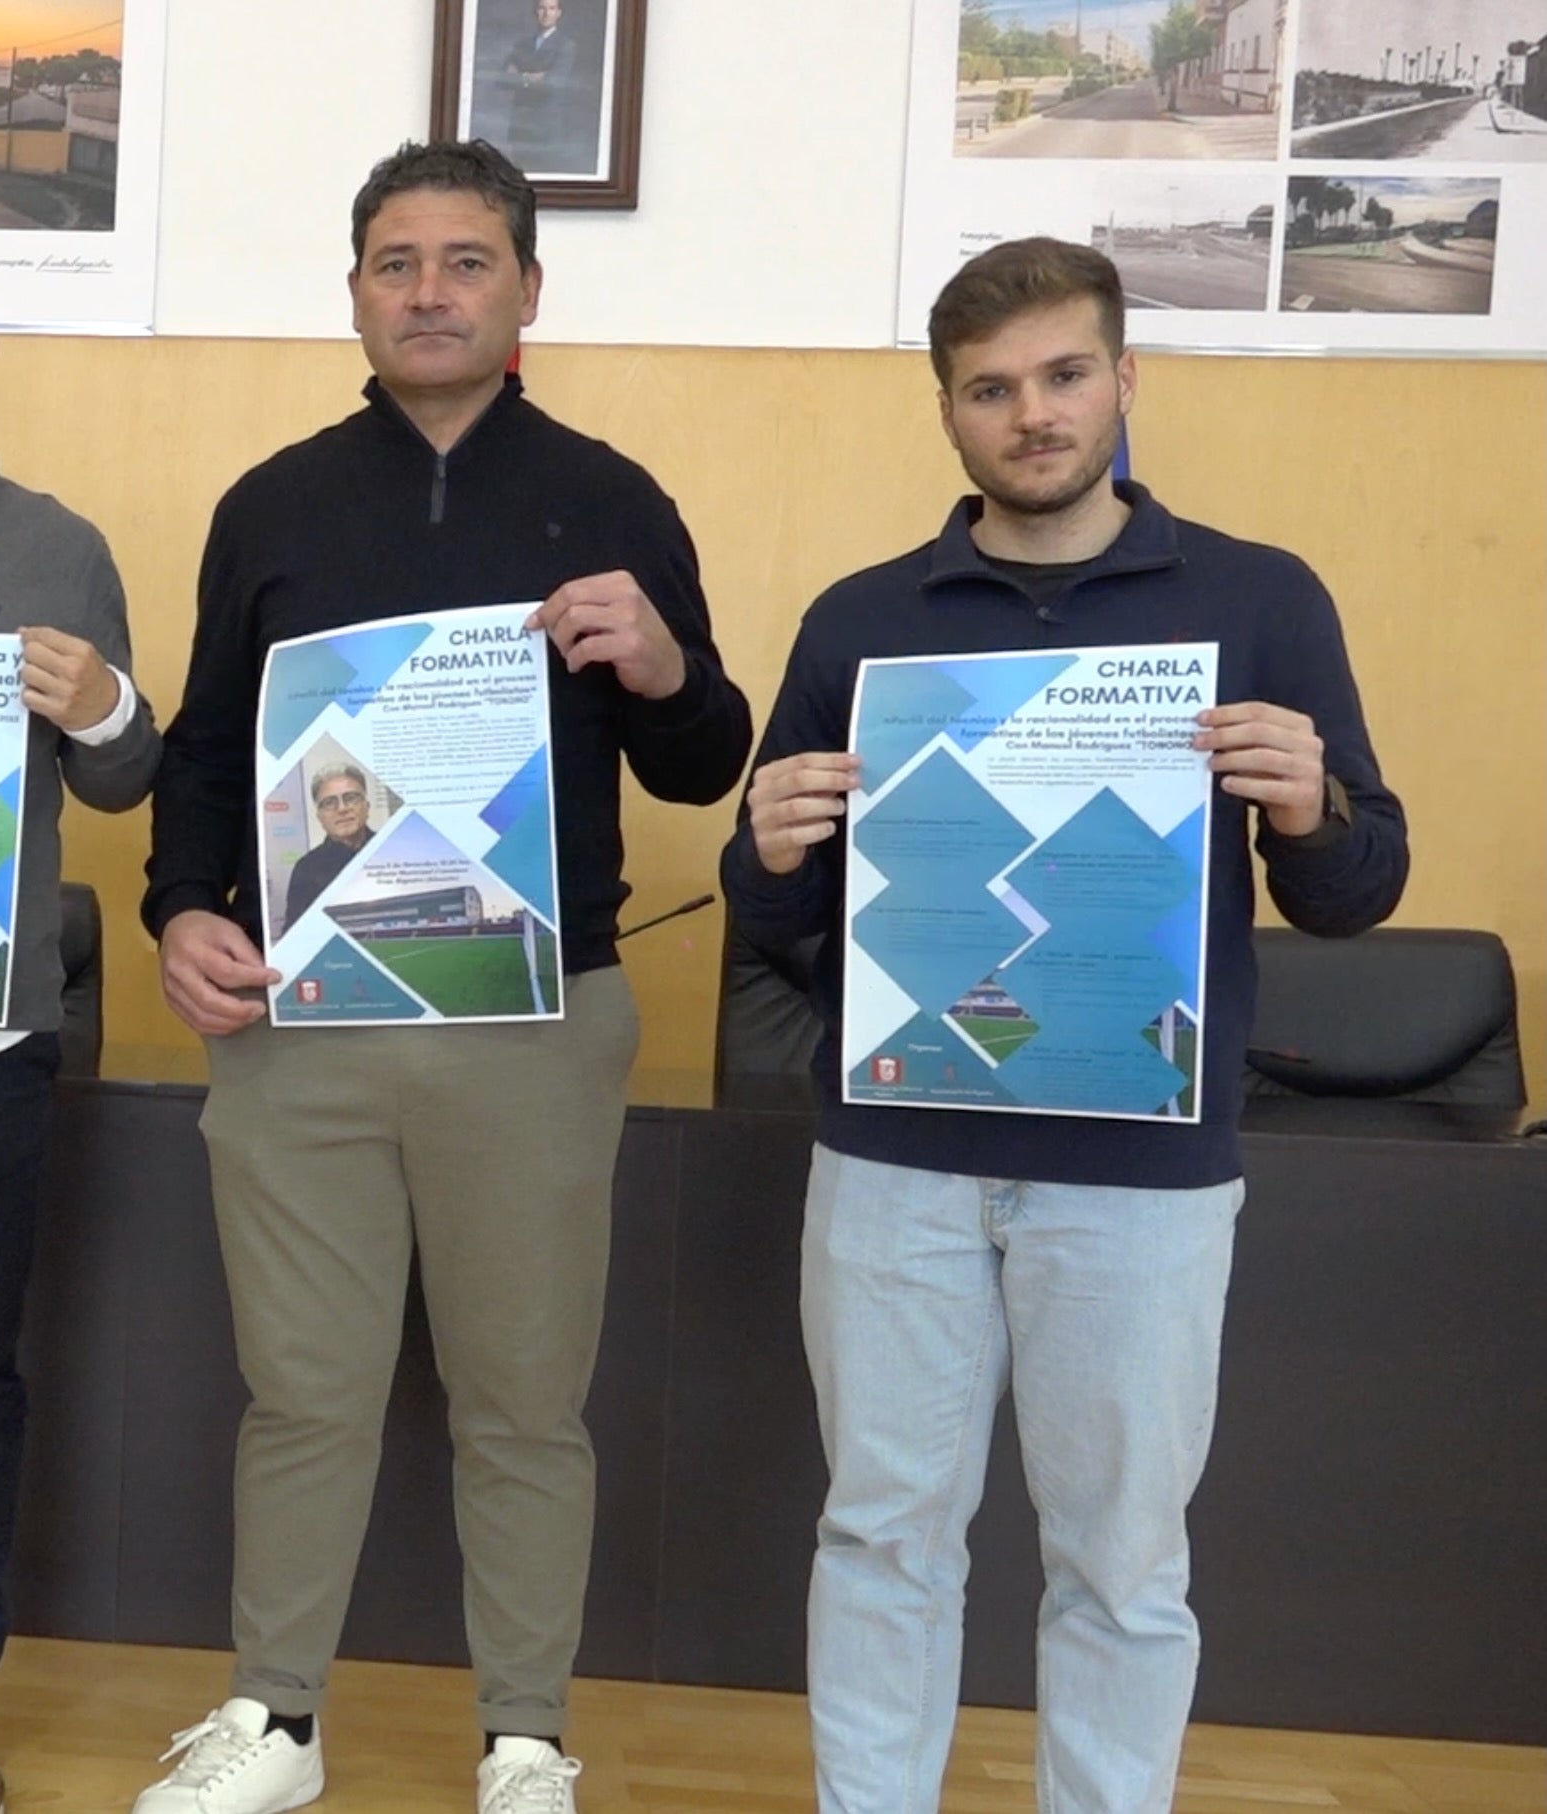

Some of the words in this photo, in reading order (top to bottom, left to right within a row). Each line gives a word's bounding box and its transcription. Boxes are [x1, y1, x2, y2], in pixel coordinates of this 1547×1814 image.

[448, 626, 533, 646] CHARLA
[13, 652, 22, 669] y
[410, 649, 533, 673] FORMATIVA
[1097, 658, 1203, 678] CHARLA
[1045, 685, 1203, 705] FORMATIVA
[1026, 713, 1111, 724] racionalidad
[1114, 716, 1131, 724] en
[1134, 713, 1146, 724] el
[1026, 728, 1042, 738] de
[1045, 727, 1065, 738] los
[1005, 740, 1028, 749] Con
[1031, 740, 1072, 749] Manuel
